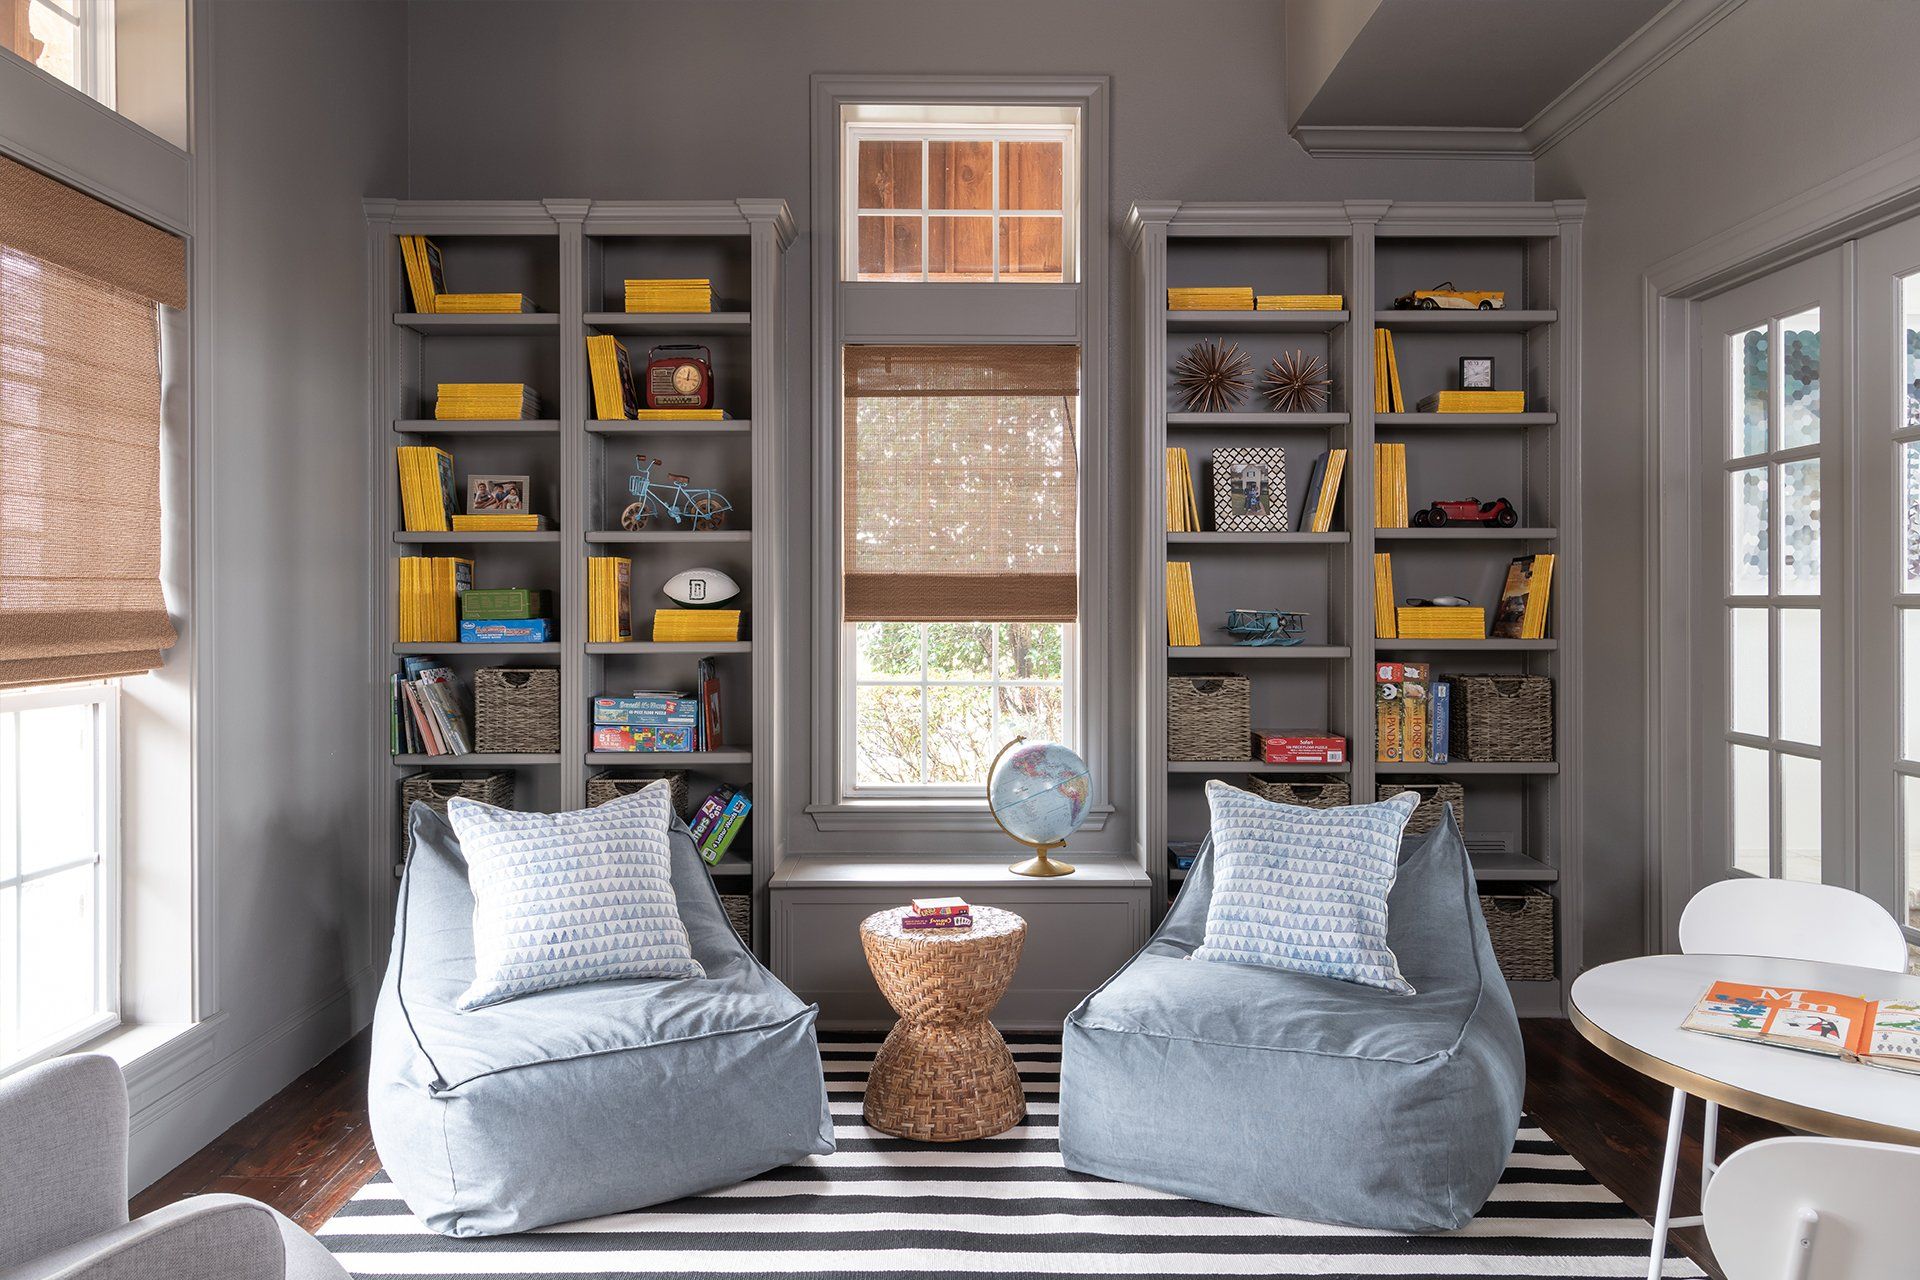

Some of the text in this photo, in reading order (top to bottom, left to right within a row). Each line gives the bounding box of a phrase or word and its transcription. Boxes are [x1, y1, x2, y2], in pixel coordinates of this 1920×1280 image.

[689, 579, 706, 600] D
[599, 734, 610, 742] 51
[1387, 717, 1396, 747] PANDA
[1412, 717, 1422, 748] HORSE
[716, 828, 727, 844] Letter
[725, 812, 738, 829] Words
[1752, 988, 1808, 1002] M
